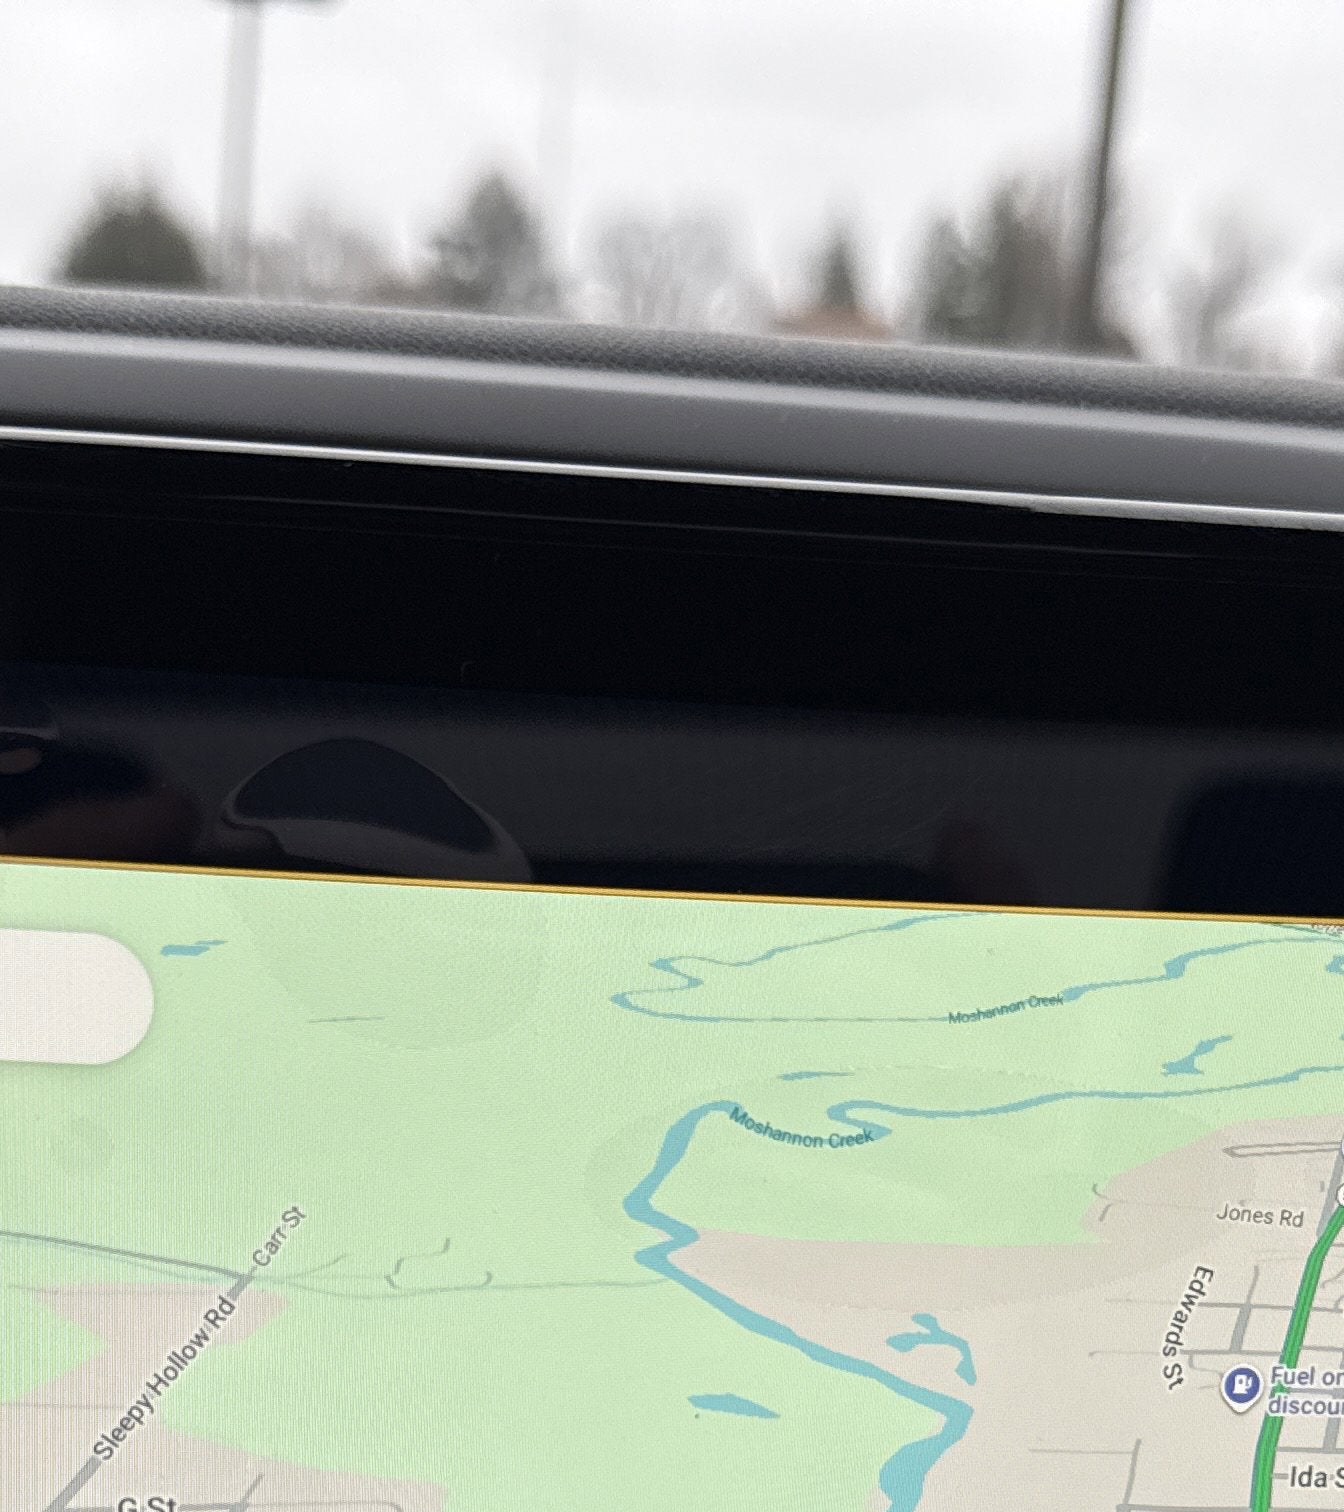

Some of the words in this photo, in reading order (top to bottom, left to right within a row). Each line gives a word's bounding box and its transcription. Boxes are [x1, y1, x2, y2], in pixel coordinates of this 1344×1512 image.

[948, 1000, 1025, 1025] Moshannon
[1028, 993, 1064, 1009] Creek
[729, 1106, 823, 1148] Moshannon
[828, 1128, 874, 1148] Creek
[1216, 1204, 1273, 1228] Jones
[1276, 1206, 1304, 1229] Rd
[253, 1228, 289, 1269] Carr
[281, 1205, 307, 1233] St
[1163, 1265, 1214, 1357] Edwards
[93, 1394, 156, 1461] Sleepy
[147, 1325, 211, 1397] Hollow
[205, 1296, 235, 1334] Rd
[1163, 1362, 1184, 1391] St
[1271, 1365, 1313, 1387] Fuel
[1290, 1466, 1327, 1488] Ida
